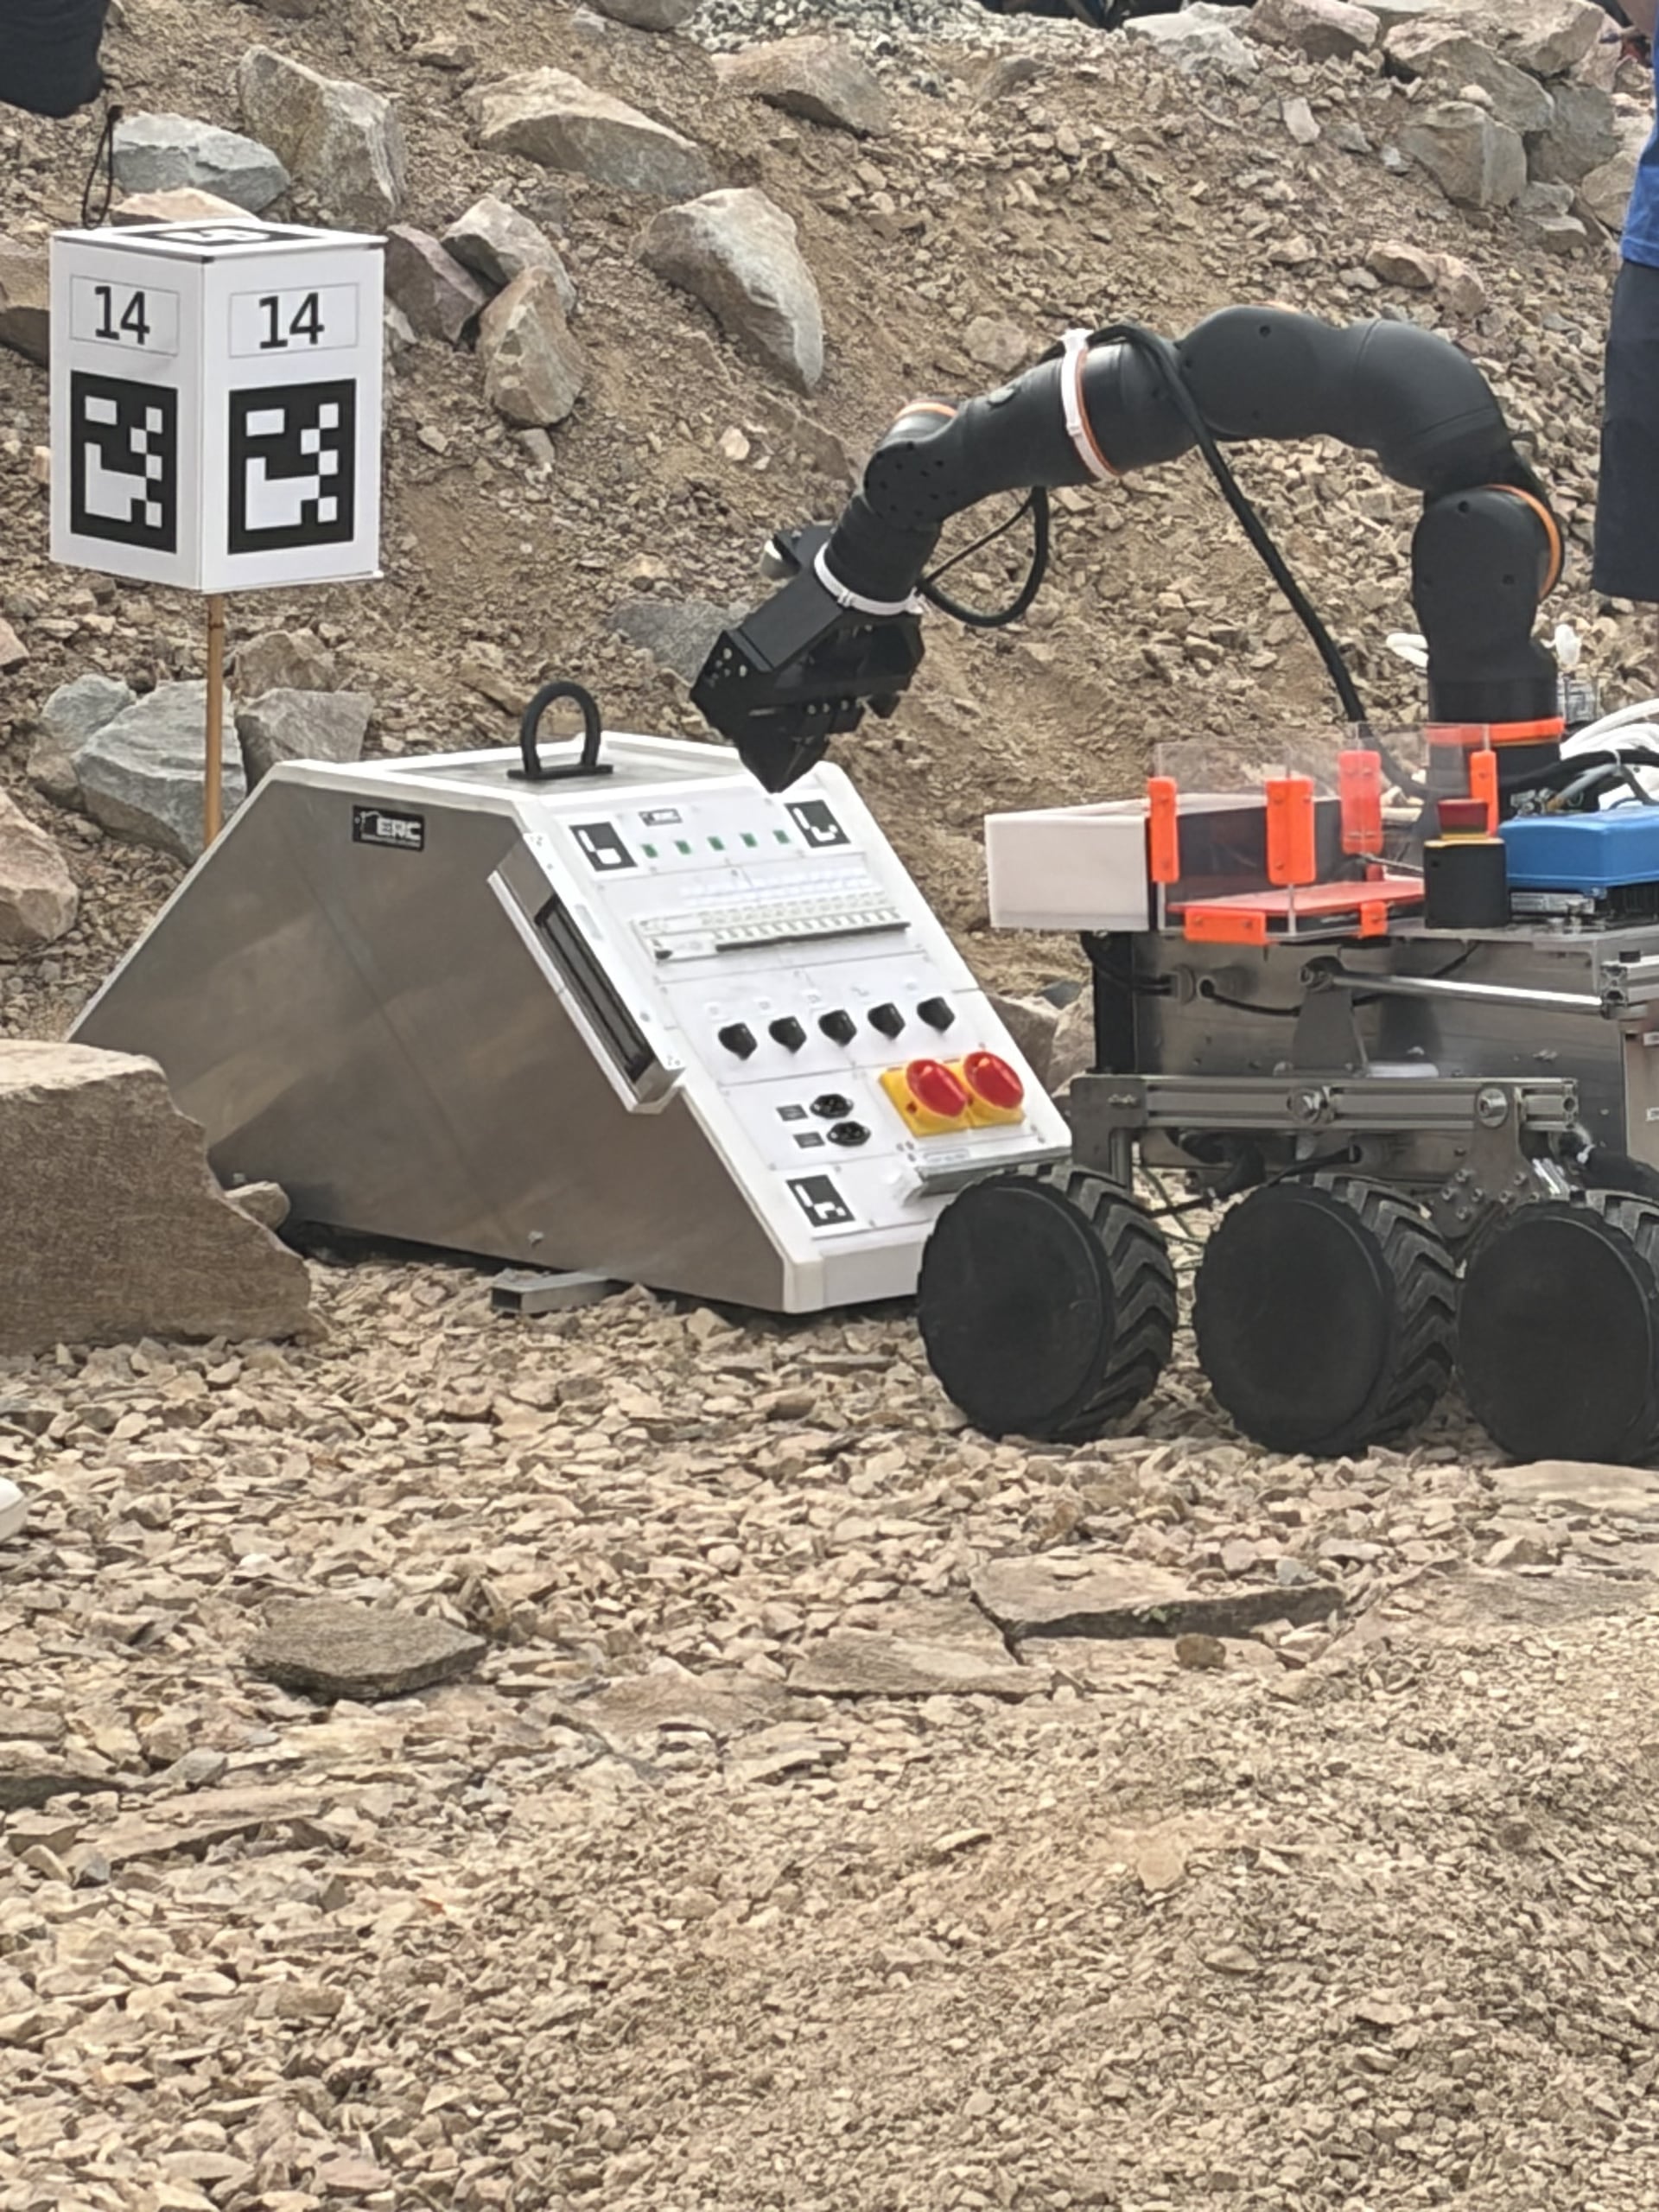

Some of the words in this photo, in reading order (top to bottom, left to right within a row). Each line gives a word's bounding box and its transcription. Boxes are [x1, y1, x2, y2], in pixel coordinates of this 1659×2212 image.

[94, 285, 150, 345] 14
[259, 292, 325, 349] 14
[376, 817, 422, 841] ERC
